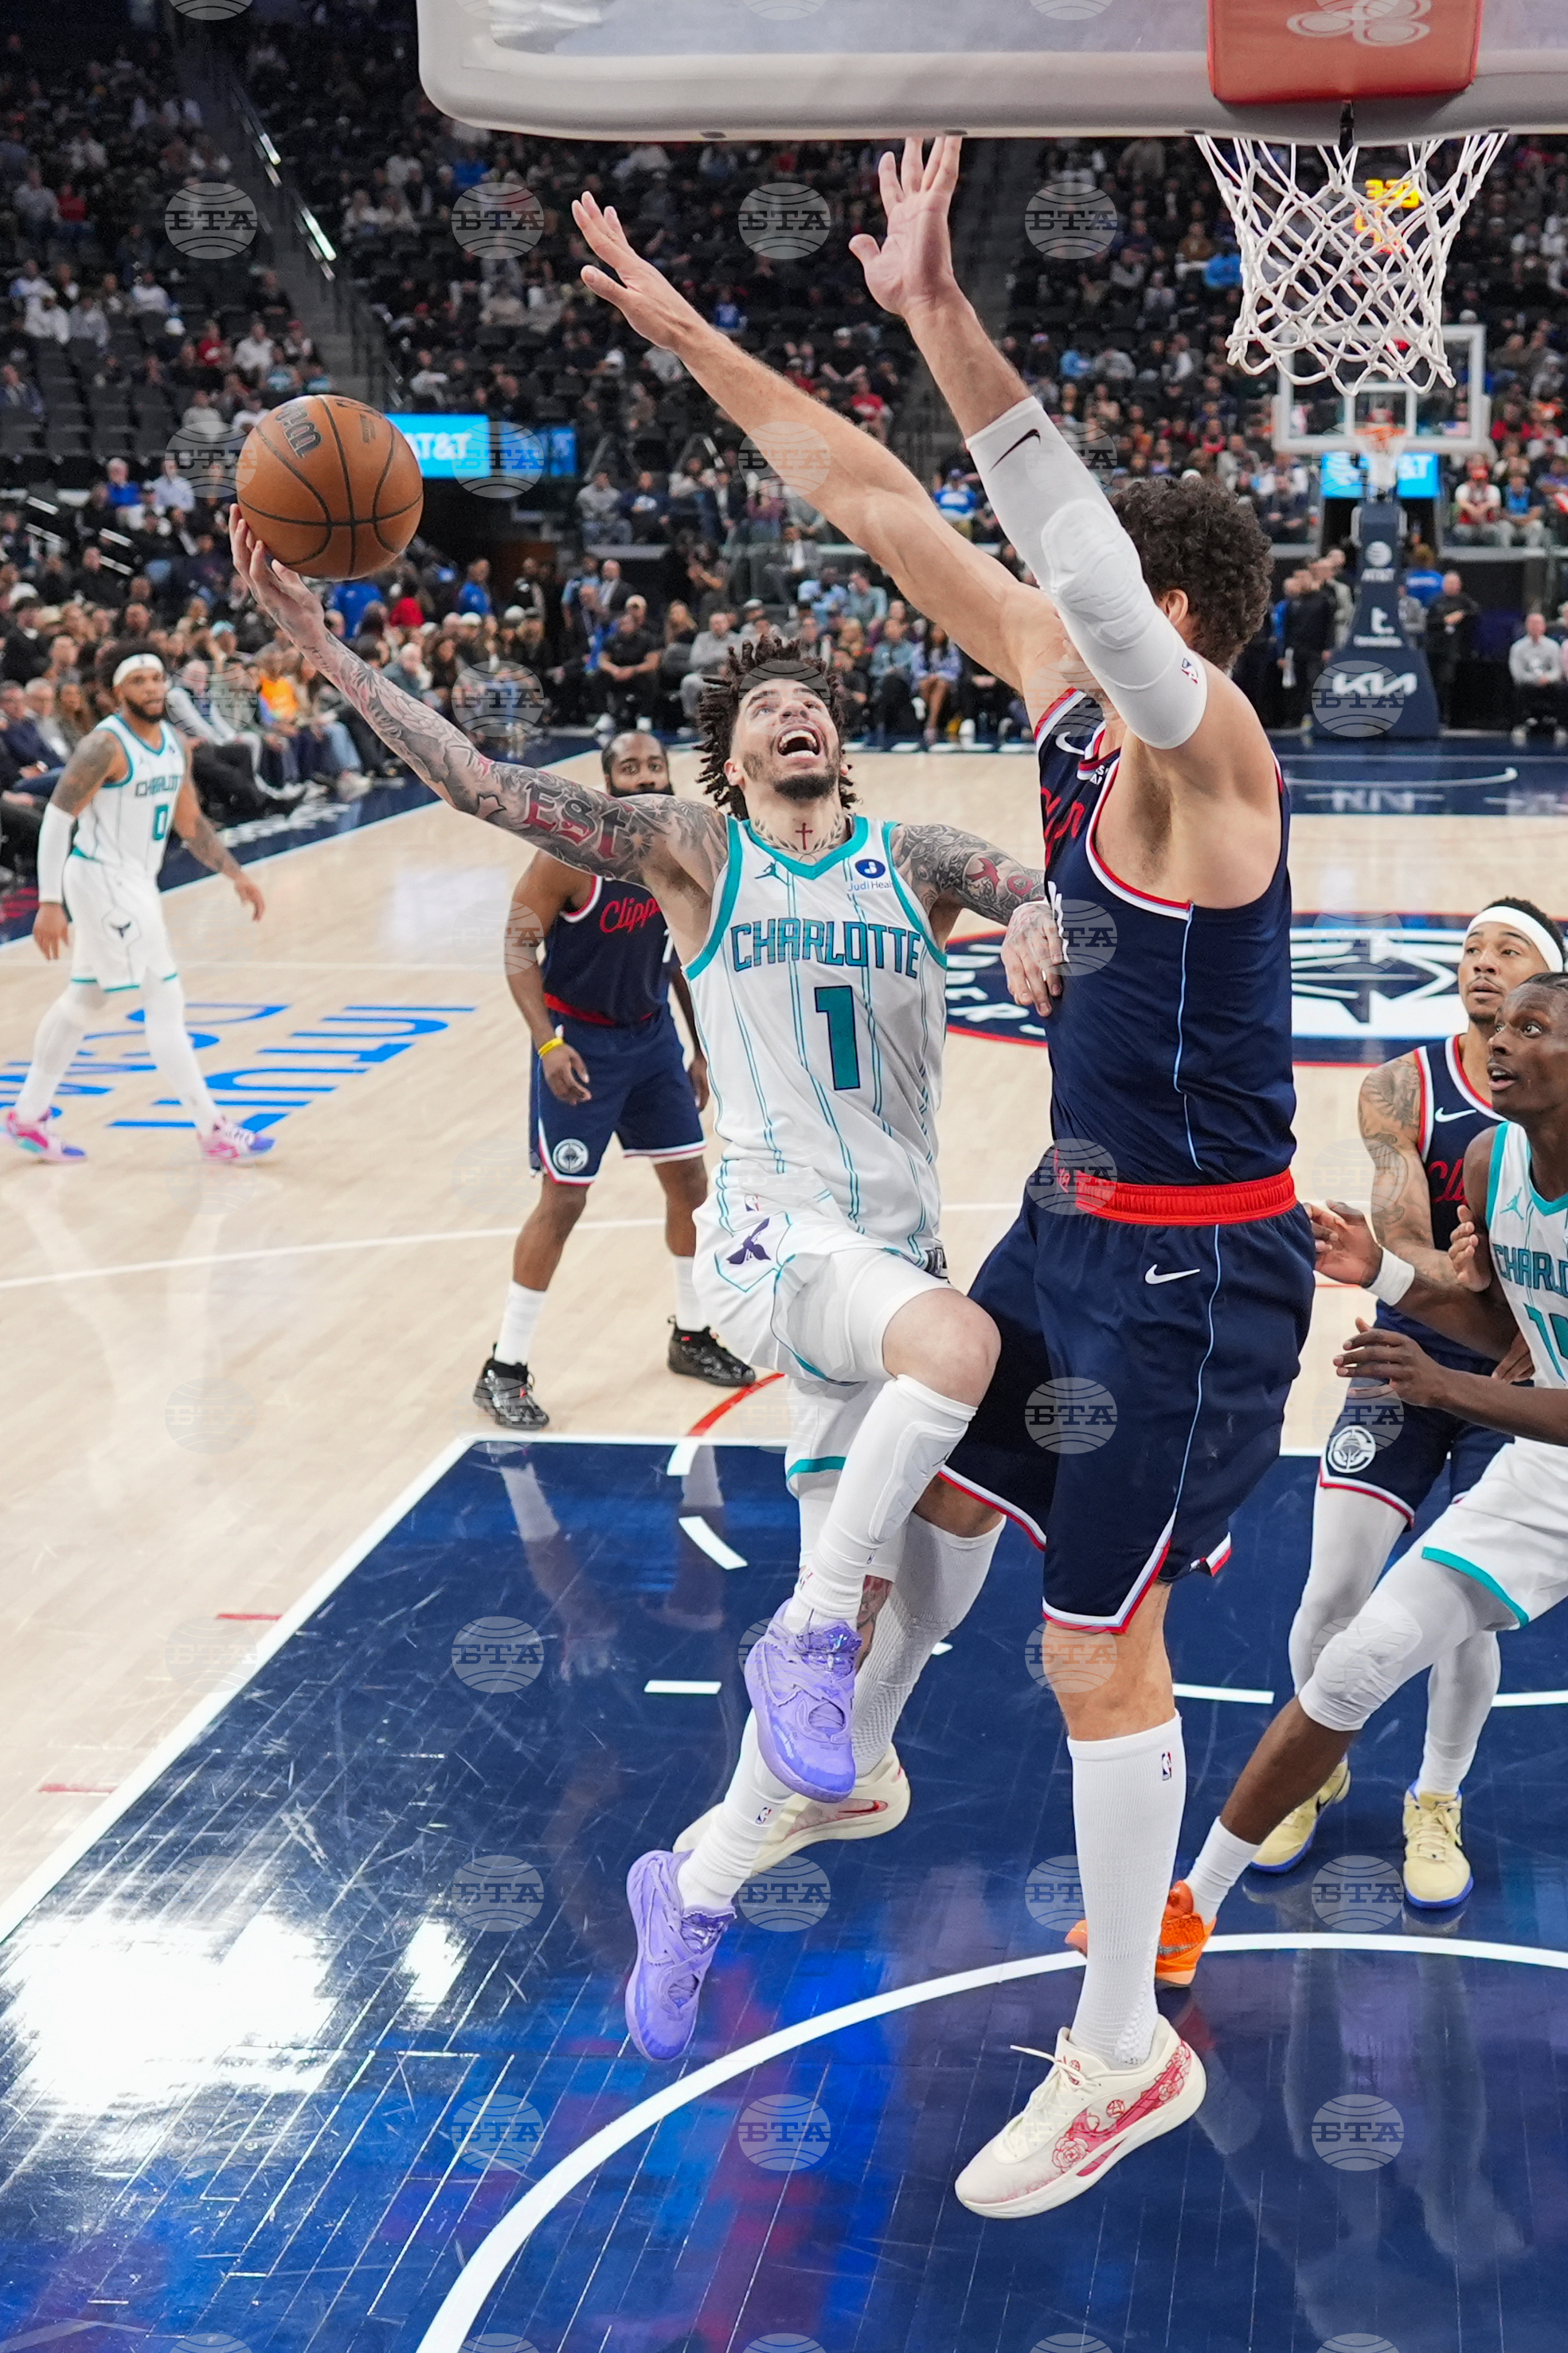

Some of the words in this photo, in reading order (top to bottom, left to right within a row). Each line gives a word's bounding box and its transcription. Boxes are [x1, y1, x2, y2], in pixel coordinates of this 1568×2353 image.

[848, 881, 870, 891] Judi
[870, 879, 893, 889] Heal
[600, 898, 661, 933] Clipp
[730, 918, 921, 979] CHARLOTTE
[814, 985, 860, 1090] 1
